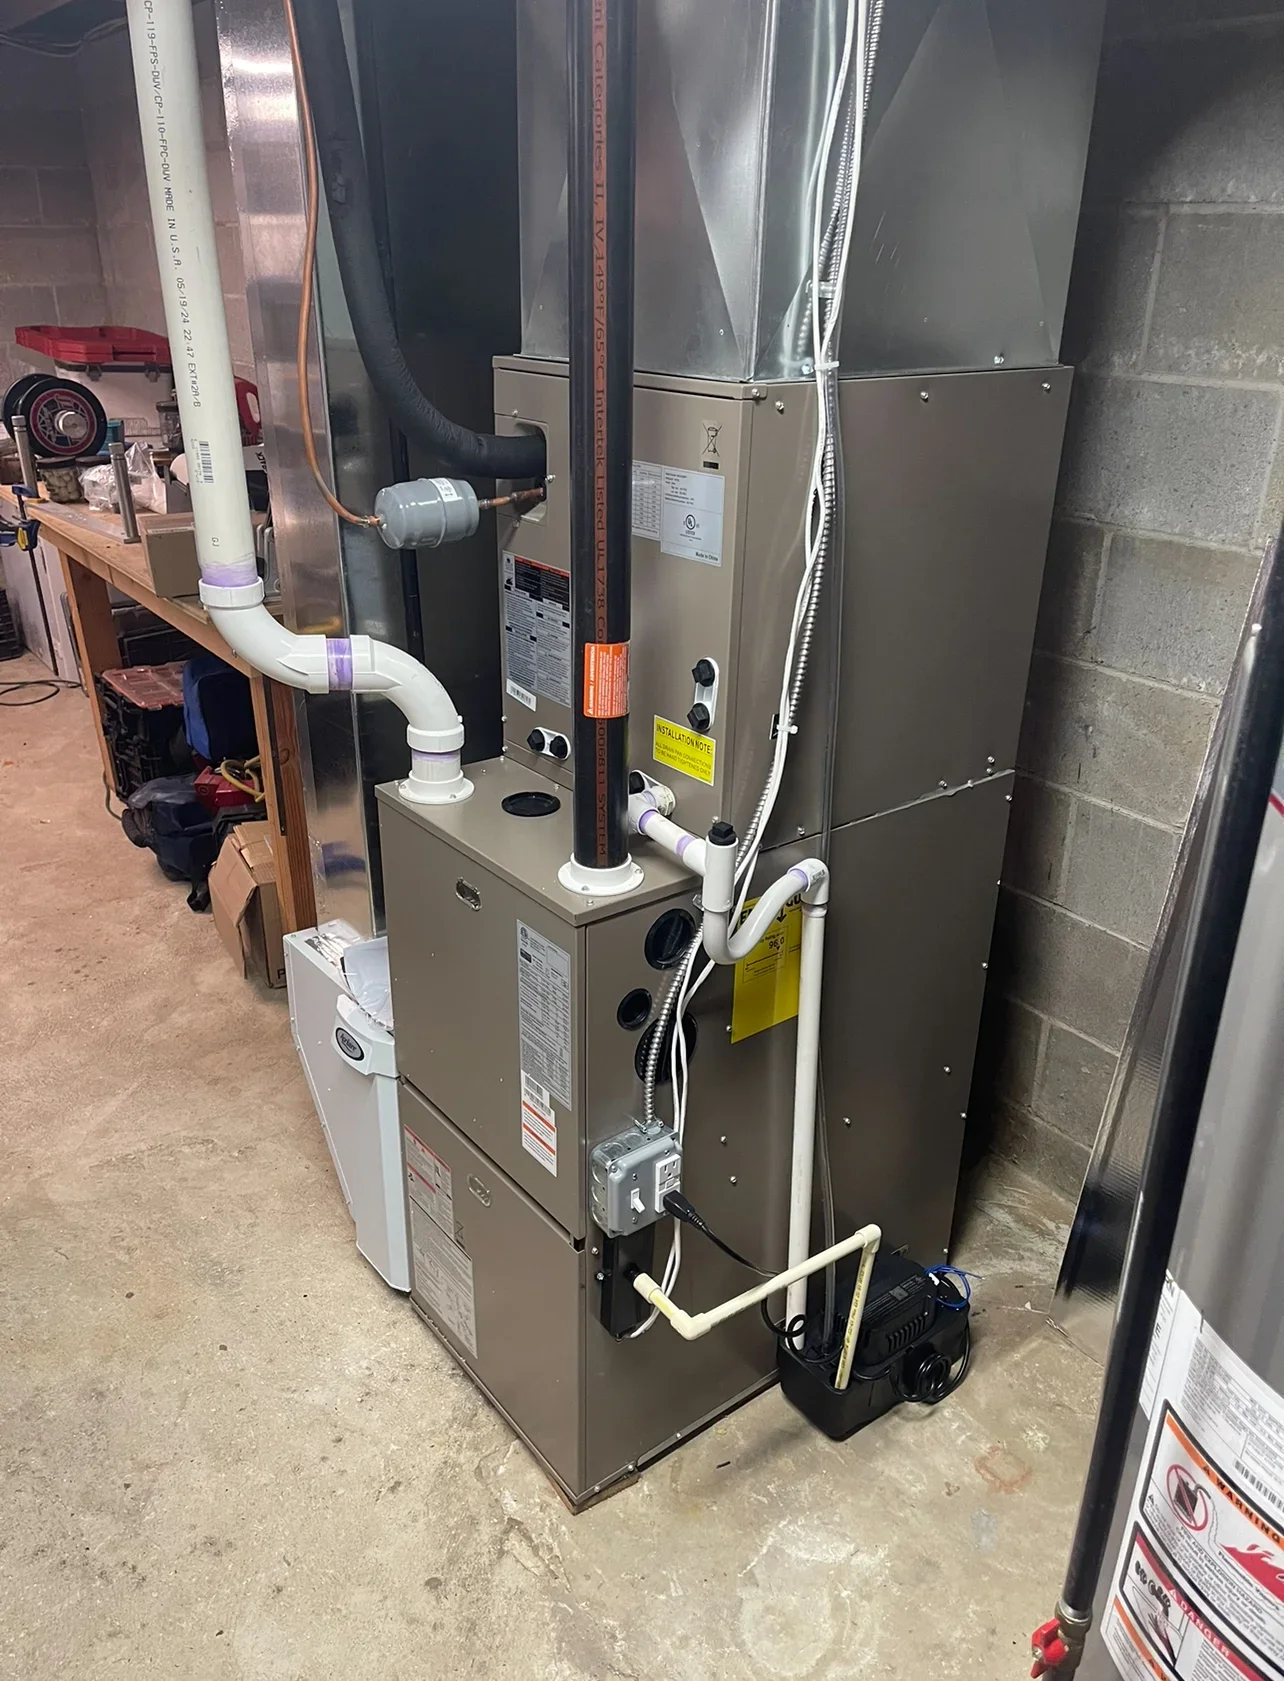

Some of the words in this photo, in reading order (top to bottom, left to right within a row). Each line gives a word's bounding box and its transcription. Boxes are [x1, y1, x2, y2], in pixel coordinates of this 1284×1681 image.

[593, 42, 604, 171] Categories
[164, 187, 175, 211] MADE
[167, 218, 176, 229] IN
[169, 234, 183, 270] U.S.A.
[176, 277, 190, 324] 05/19/24
[595, 389, 606, 467] Intertek
[595, 476, 606, 531] Listed
[211, 537, 220, 547] GJ
[657, 724, 695, 747] INSTALLATION
[597, 794, 606, 855] SYSTEM
[768, 936, 785, 950] 96.0
[1216, 1477, 1280, 1543] WARNING
[1192, 1541, 1204, 1555] AND
[1204, 1553, 1236, 1589] EXPLOSION
[1236, 1586, 1263, 1614] HAZARD
[1218, 1551, 1253, 1588] Flammable
[1180, 1601, 1231, 1657] DANGER
